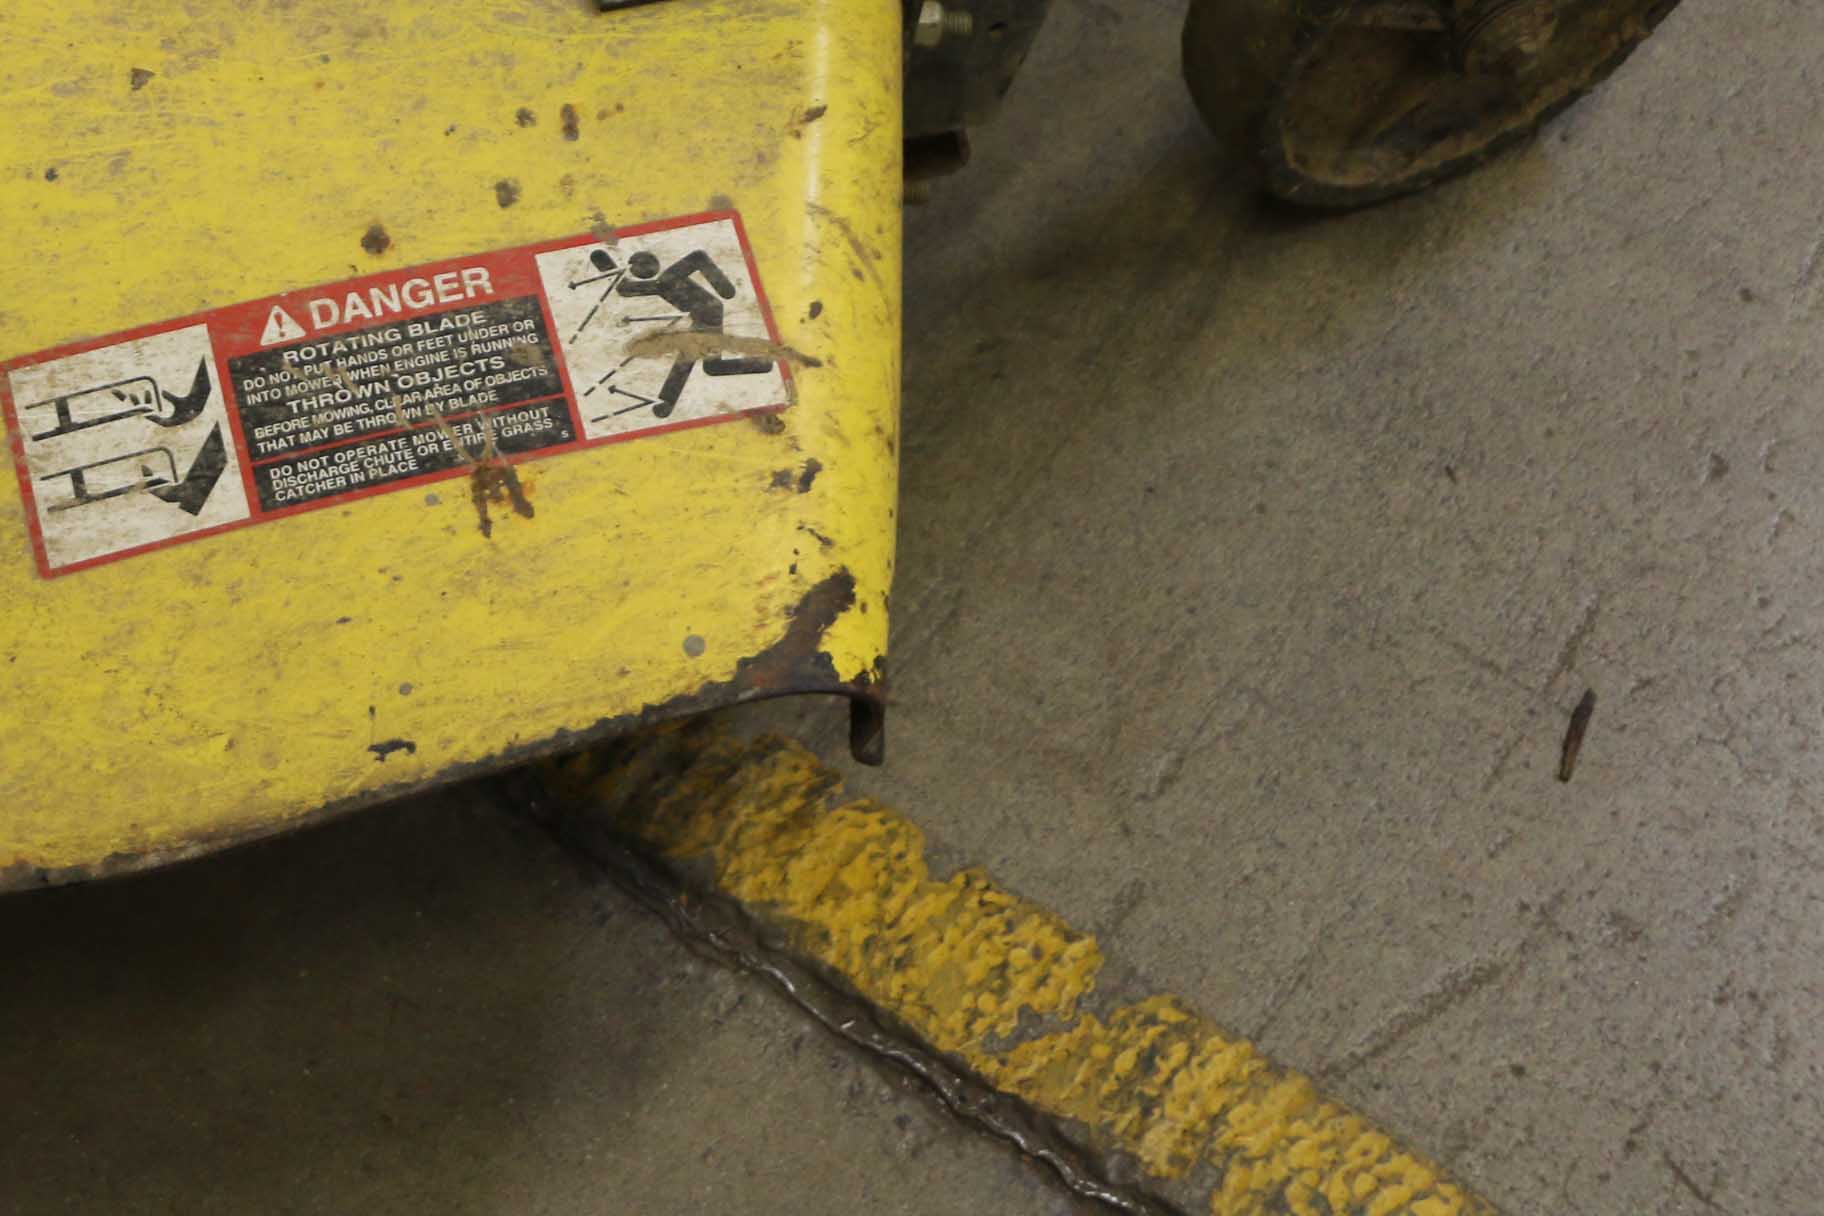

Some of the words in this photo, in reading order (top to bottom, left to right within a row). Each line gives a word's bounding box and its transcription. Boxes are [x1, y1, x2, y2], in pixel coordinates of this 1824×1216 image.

[309, 267, 494, 329] DANGER
[243, 376, 265, 391] DO
[269, 368, 300, 384] NO
[336, 349, 388, 369] HANDS
[391, 343, 414, 357] OR
[417, 334, 454, 352] FEET
[458, 323, 510, 343] UNDER
[512, 319, 536, 333] OR
[283, 328, 402, 363] ROTATING
[407, 310, 488, 337] BLADE
[246, 388, 282, 405] INTO
[347, 362, 390, 381] WHEN
[394, 350, 450, 372] ENGINE
[453, 347, 468, 359] IS
[254, 416, 310, 440] BEFORE
[375, 390, 423, 412] CLAR
[423, 384, 463, 400] AREA
[463, 378, 484, 393] OF
[484, 366, 548, 387] OBJECTS
[286, 379, 391, 414] THROWN
[398, 356, 506, 390] OBJECTS
[257, 434, 296, 454] THAT
[299, 427, 329, 444] MAY
[333, 421, 354, 436] BE
[448, 390, 499, 410] BLADE
[269, 464, 292, 480] DO
[297, 455, 329, 473] NOT
[334, 437, 408, 463] OPERATE
[272, 460, 364, 491] DISCHARGE
[363, 448, 414, 468] CHUTE
[416, 441, 440, 456] OR
[501, 417, 554, 437] GRASS
[274, 475, 347, 502] CATCHER
[350, 471, 366, 484] IN
[369, 458, 419, 480] PLACE
